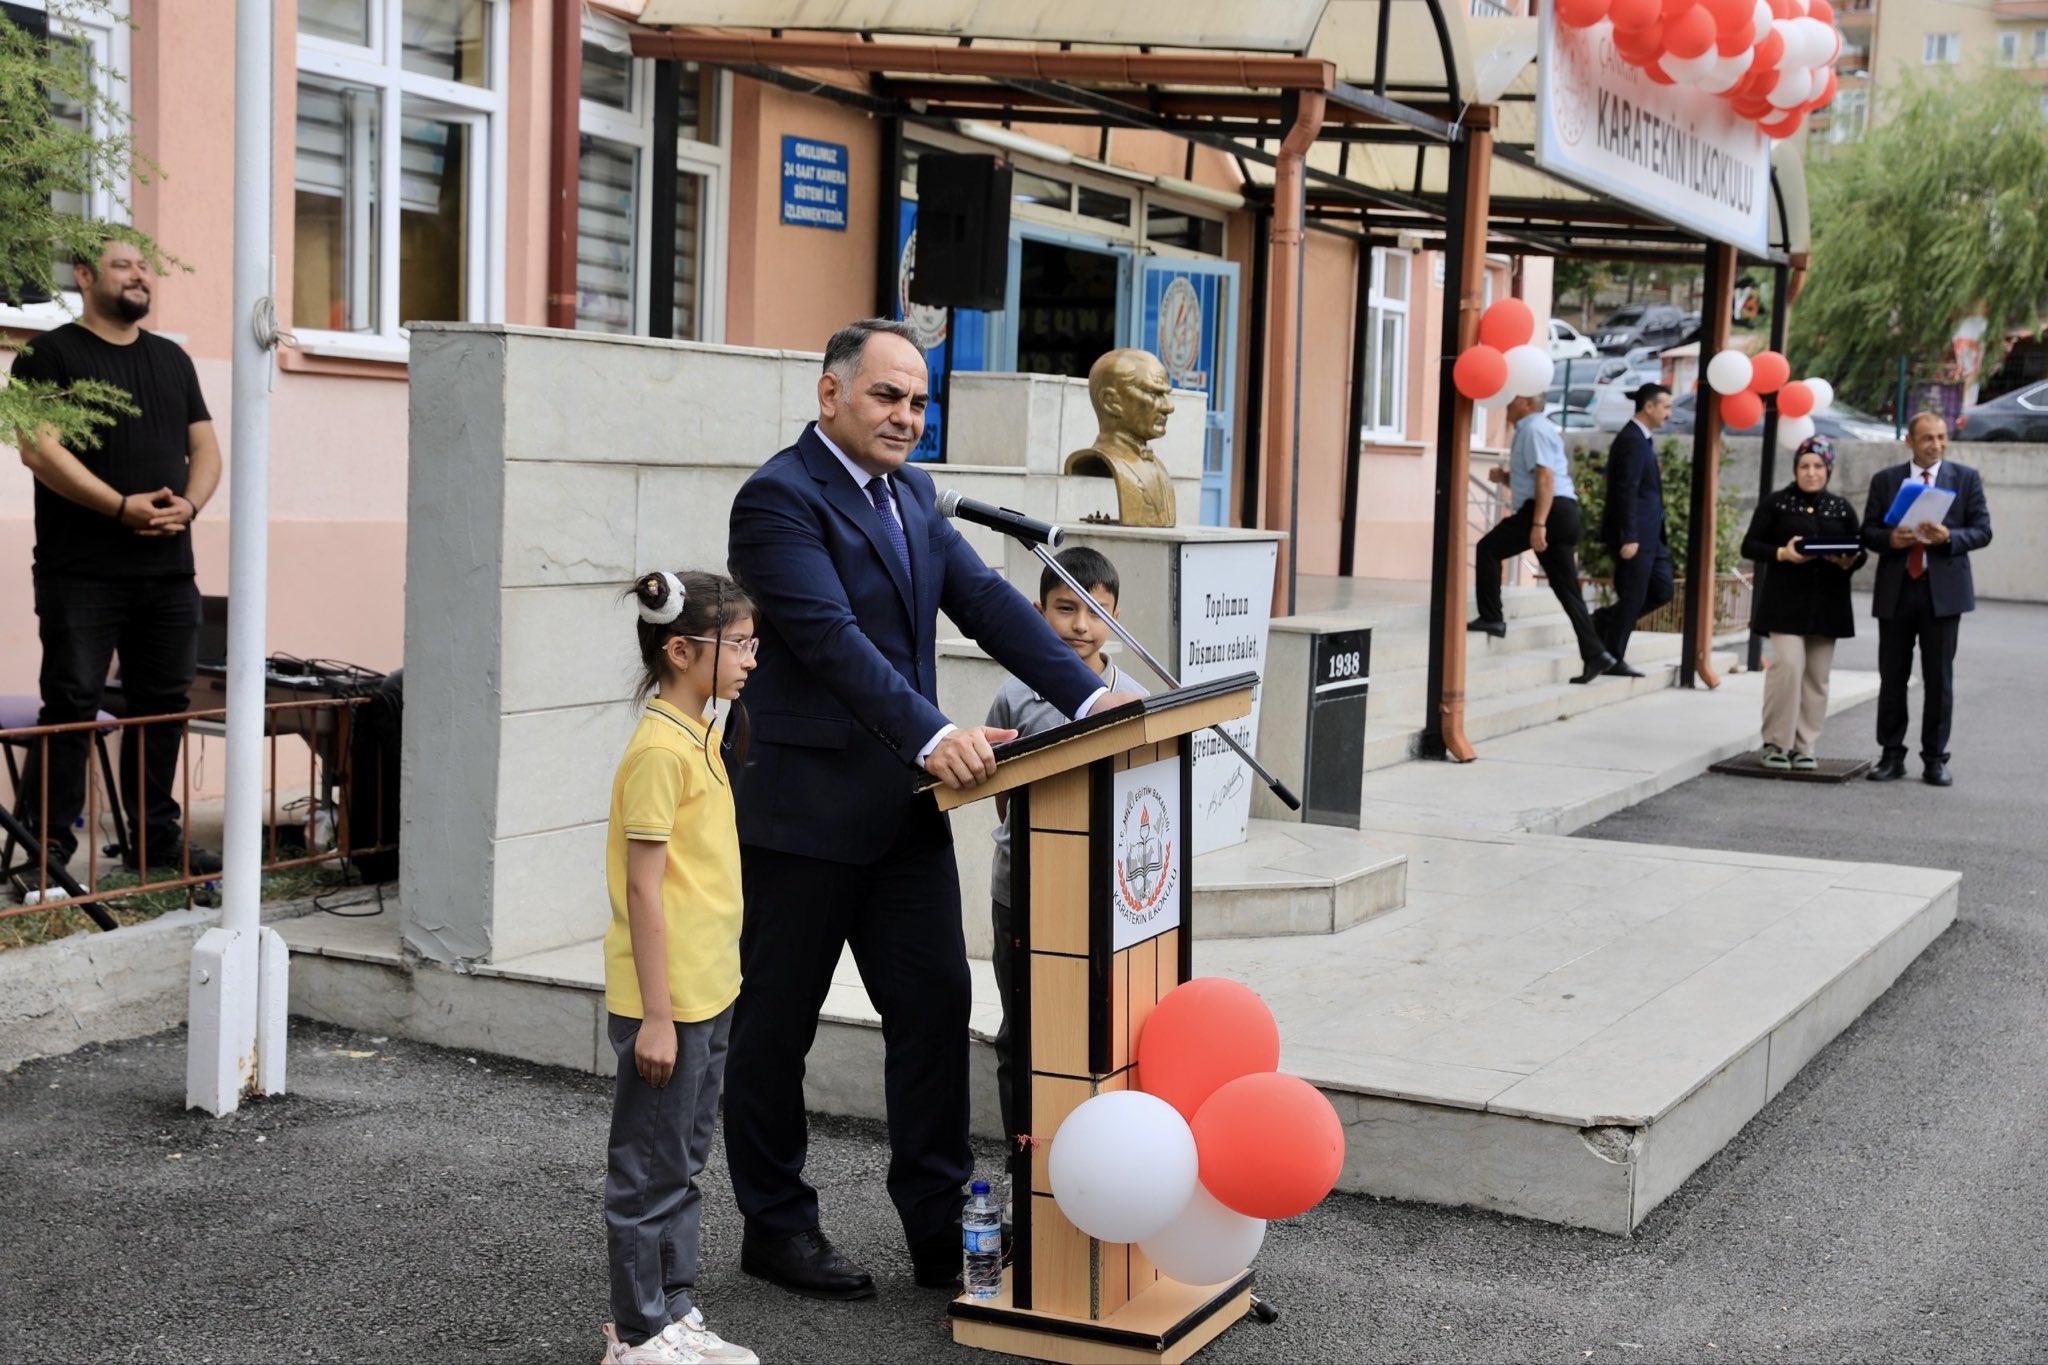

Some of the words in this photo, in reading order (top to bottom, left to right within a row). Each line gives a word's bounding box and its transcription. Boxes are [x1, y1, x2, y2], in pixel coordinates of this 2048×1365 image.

[1597, 87, 1686, 185] KARATEKİN
[1688, 122, 1754, 215] İLKOKULU
[1205, 593, 1249, 625] Toplumun
[1188, 640, 1226, 673] Düşmanı
[1328, 651, 1360, 679] 1938
[1113, 890, 1148, 925] KARATEKİN
[1148, 867, 1178, 922] İLKOKULU
